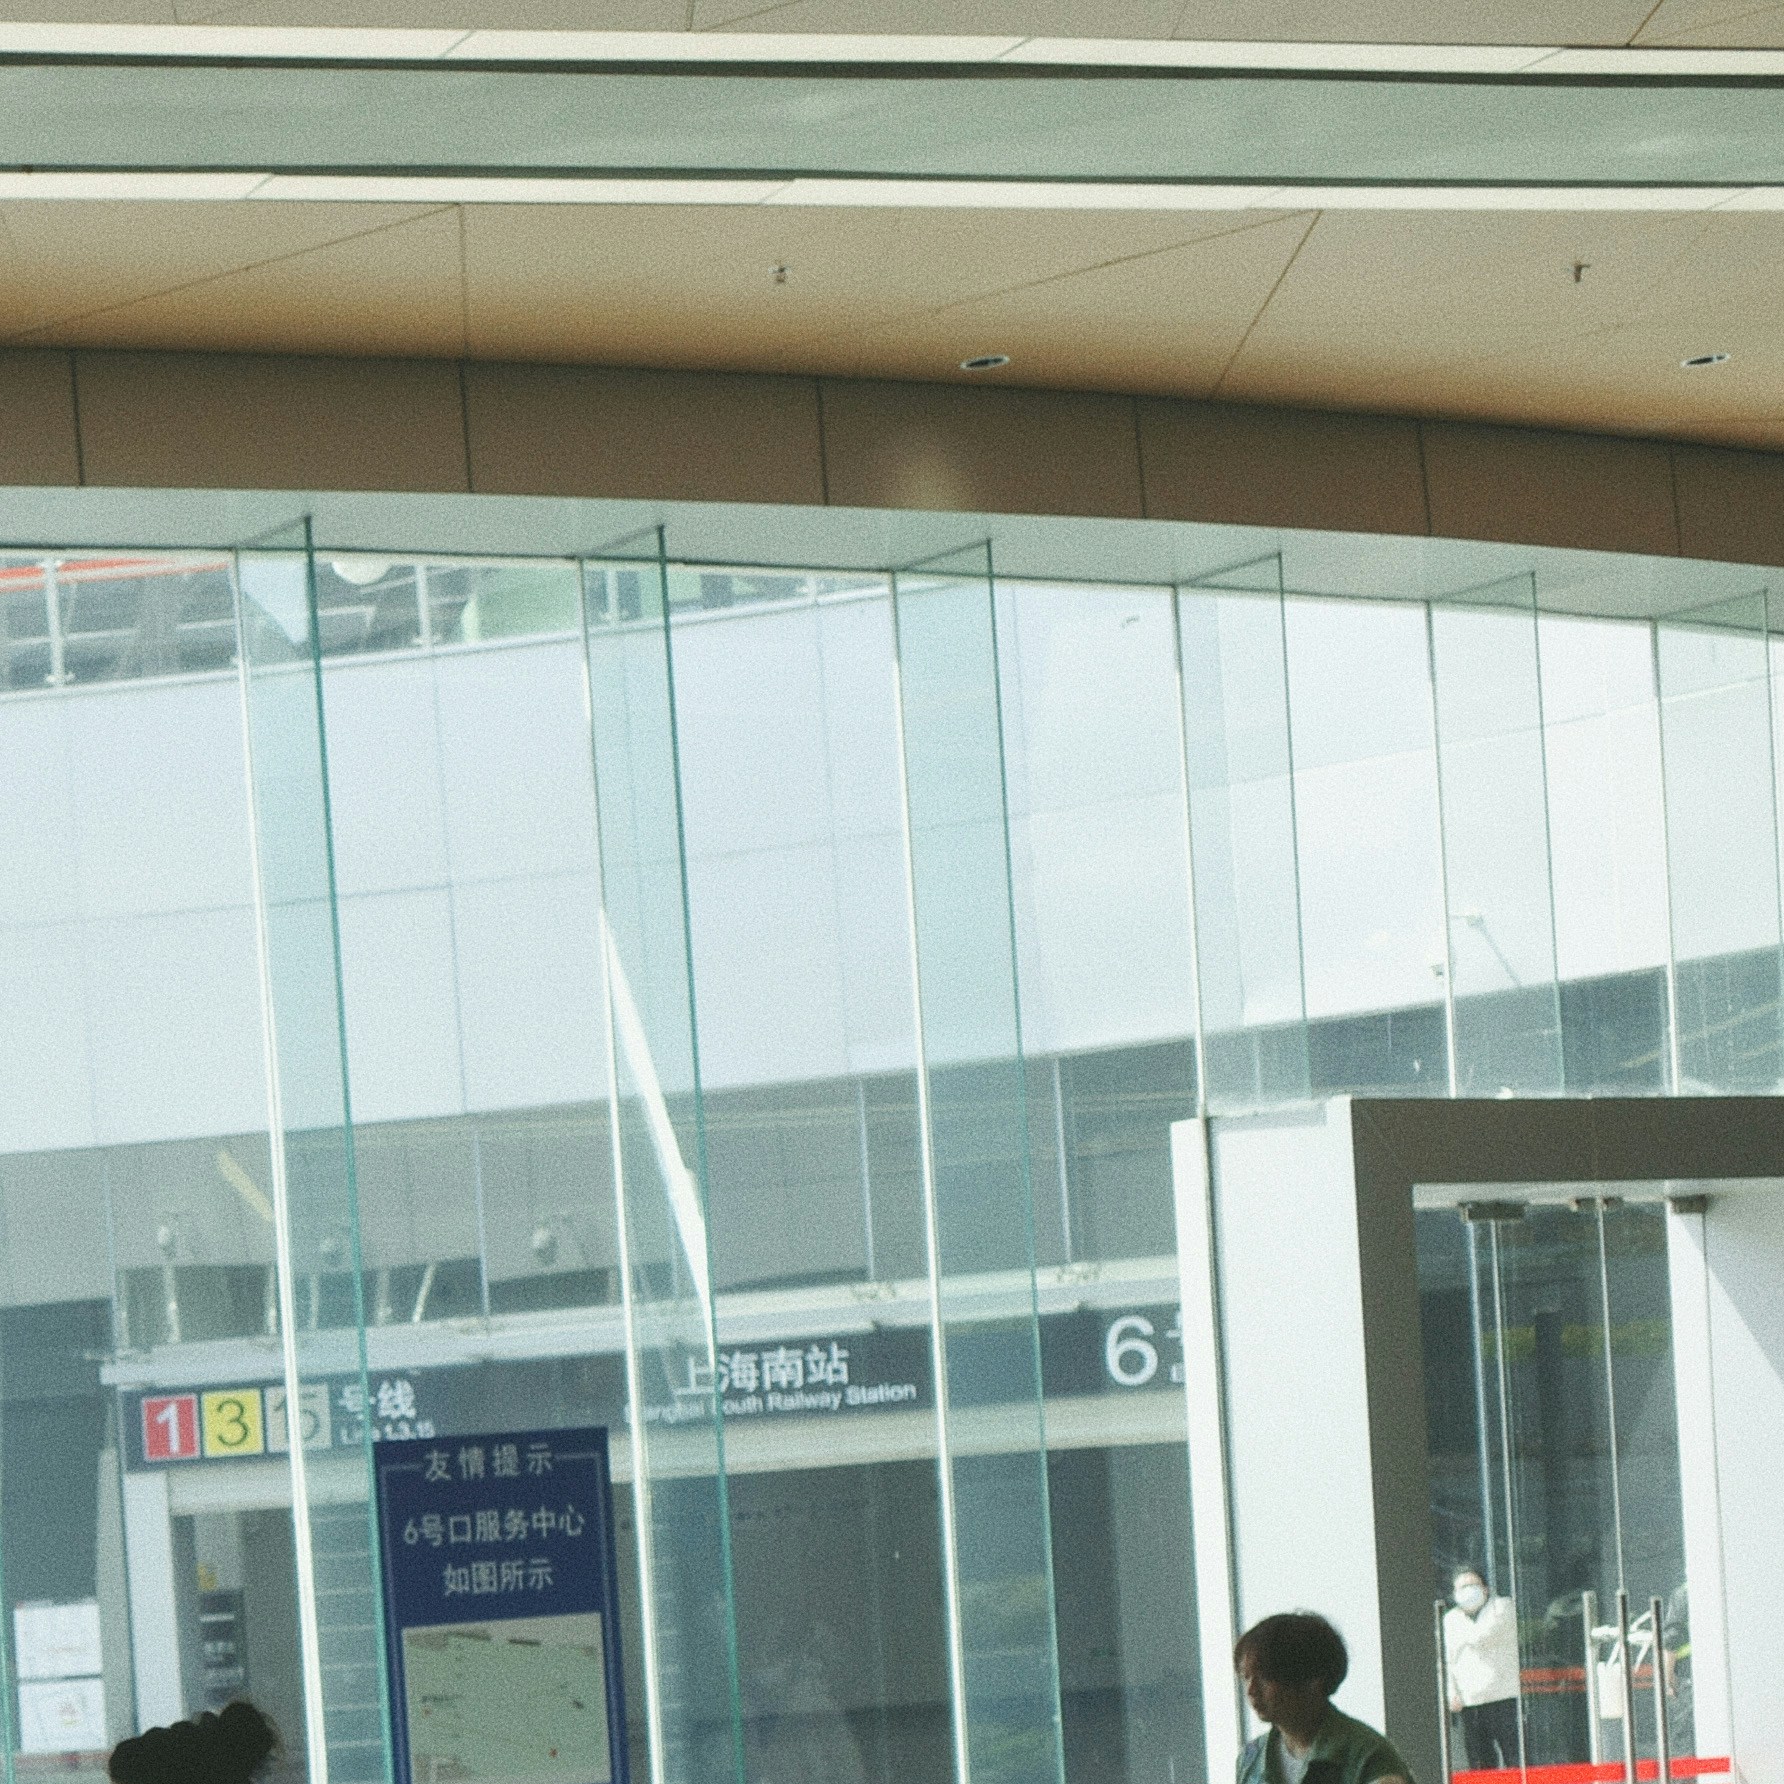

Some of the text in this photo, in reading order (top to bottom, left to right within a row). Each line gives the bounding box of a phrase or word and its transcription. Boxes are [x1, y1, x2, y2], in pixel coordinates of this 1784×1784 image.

[672, 1341, 850, 1395] 上海南站
[1106, 1314, 1159, 1387] 6
[845, 1382, 918, 1406] Station
[156, 1403, 180, 1454] 1
[216, 1399, 249, 1447] 3
[425, 1443, 554, 1482] 友情提示
[403, 1503, 585, 1547] 6号口服务中心
[443, 1557, 554, 1597] 如图所示
